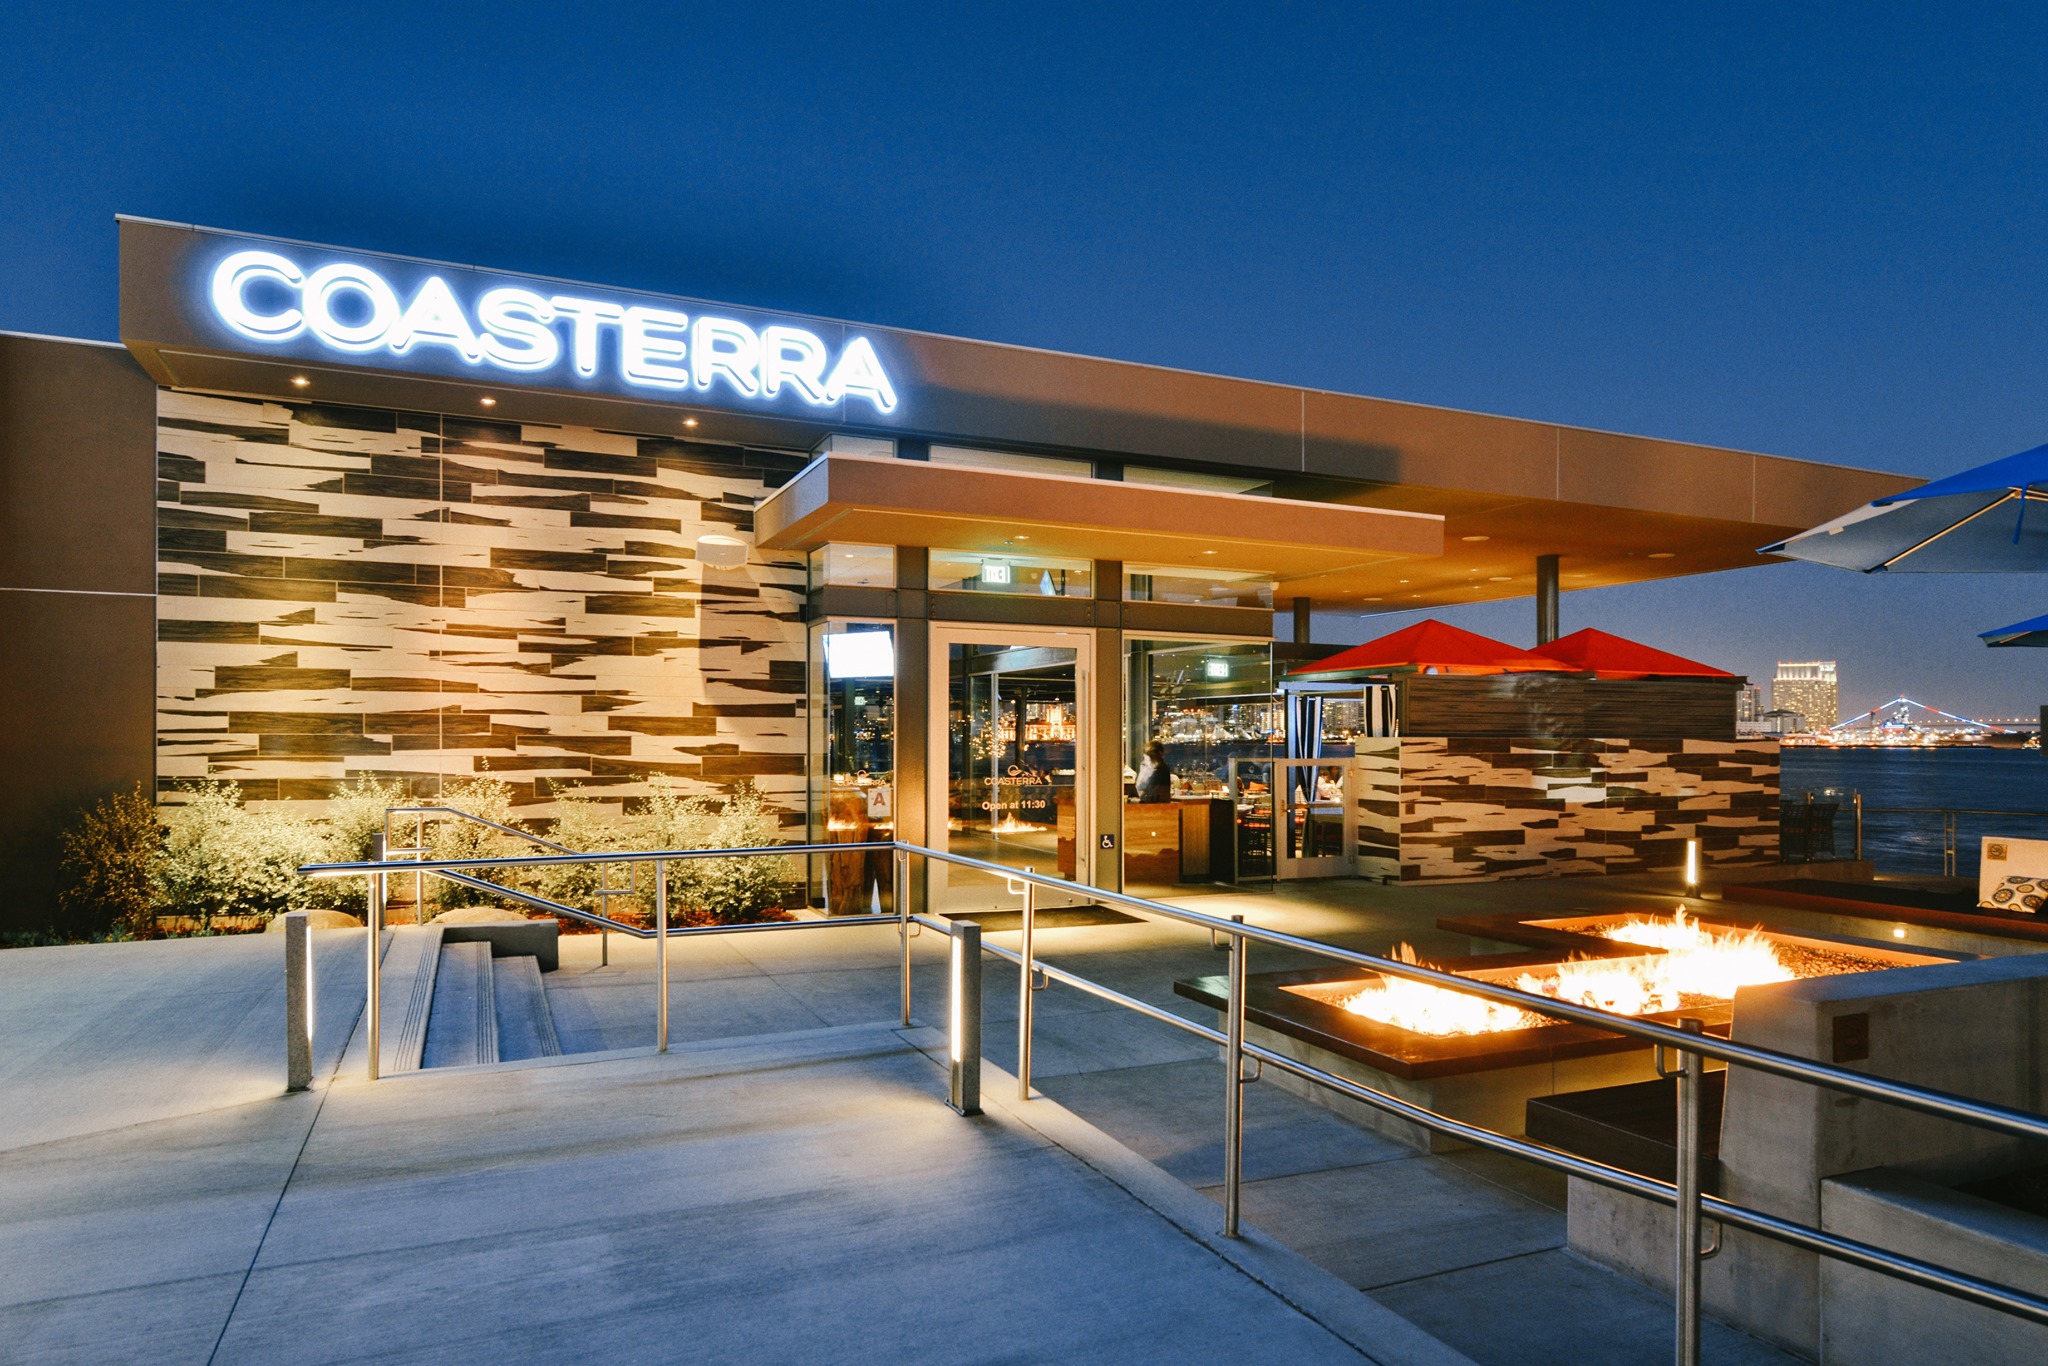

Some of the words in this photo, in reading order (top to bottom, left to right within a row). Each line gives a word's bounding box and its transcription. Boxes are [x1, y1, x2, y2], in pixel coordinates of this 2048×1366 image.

[212, 251, 898, 413] COASTERRA
[984, 776, 1042, 785] COASTERRA
[873, 792, 886, 806] A
[981, 801, 1008, 812] Open
[1009, 801, 1020, 809] at
[1021, 800, 1046, 809] 11:30
